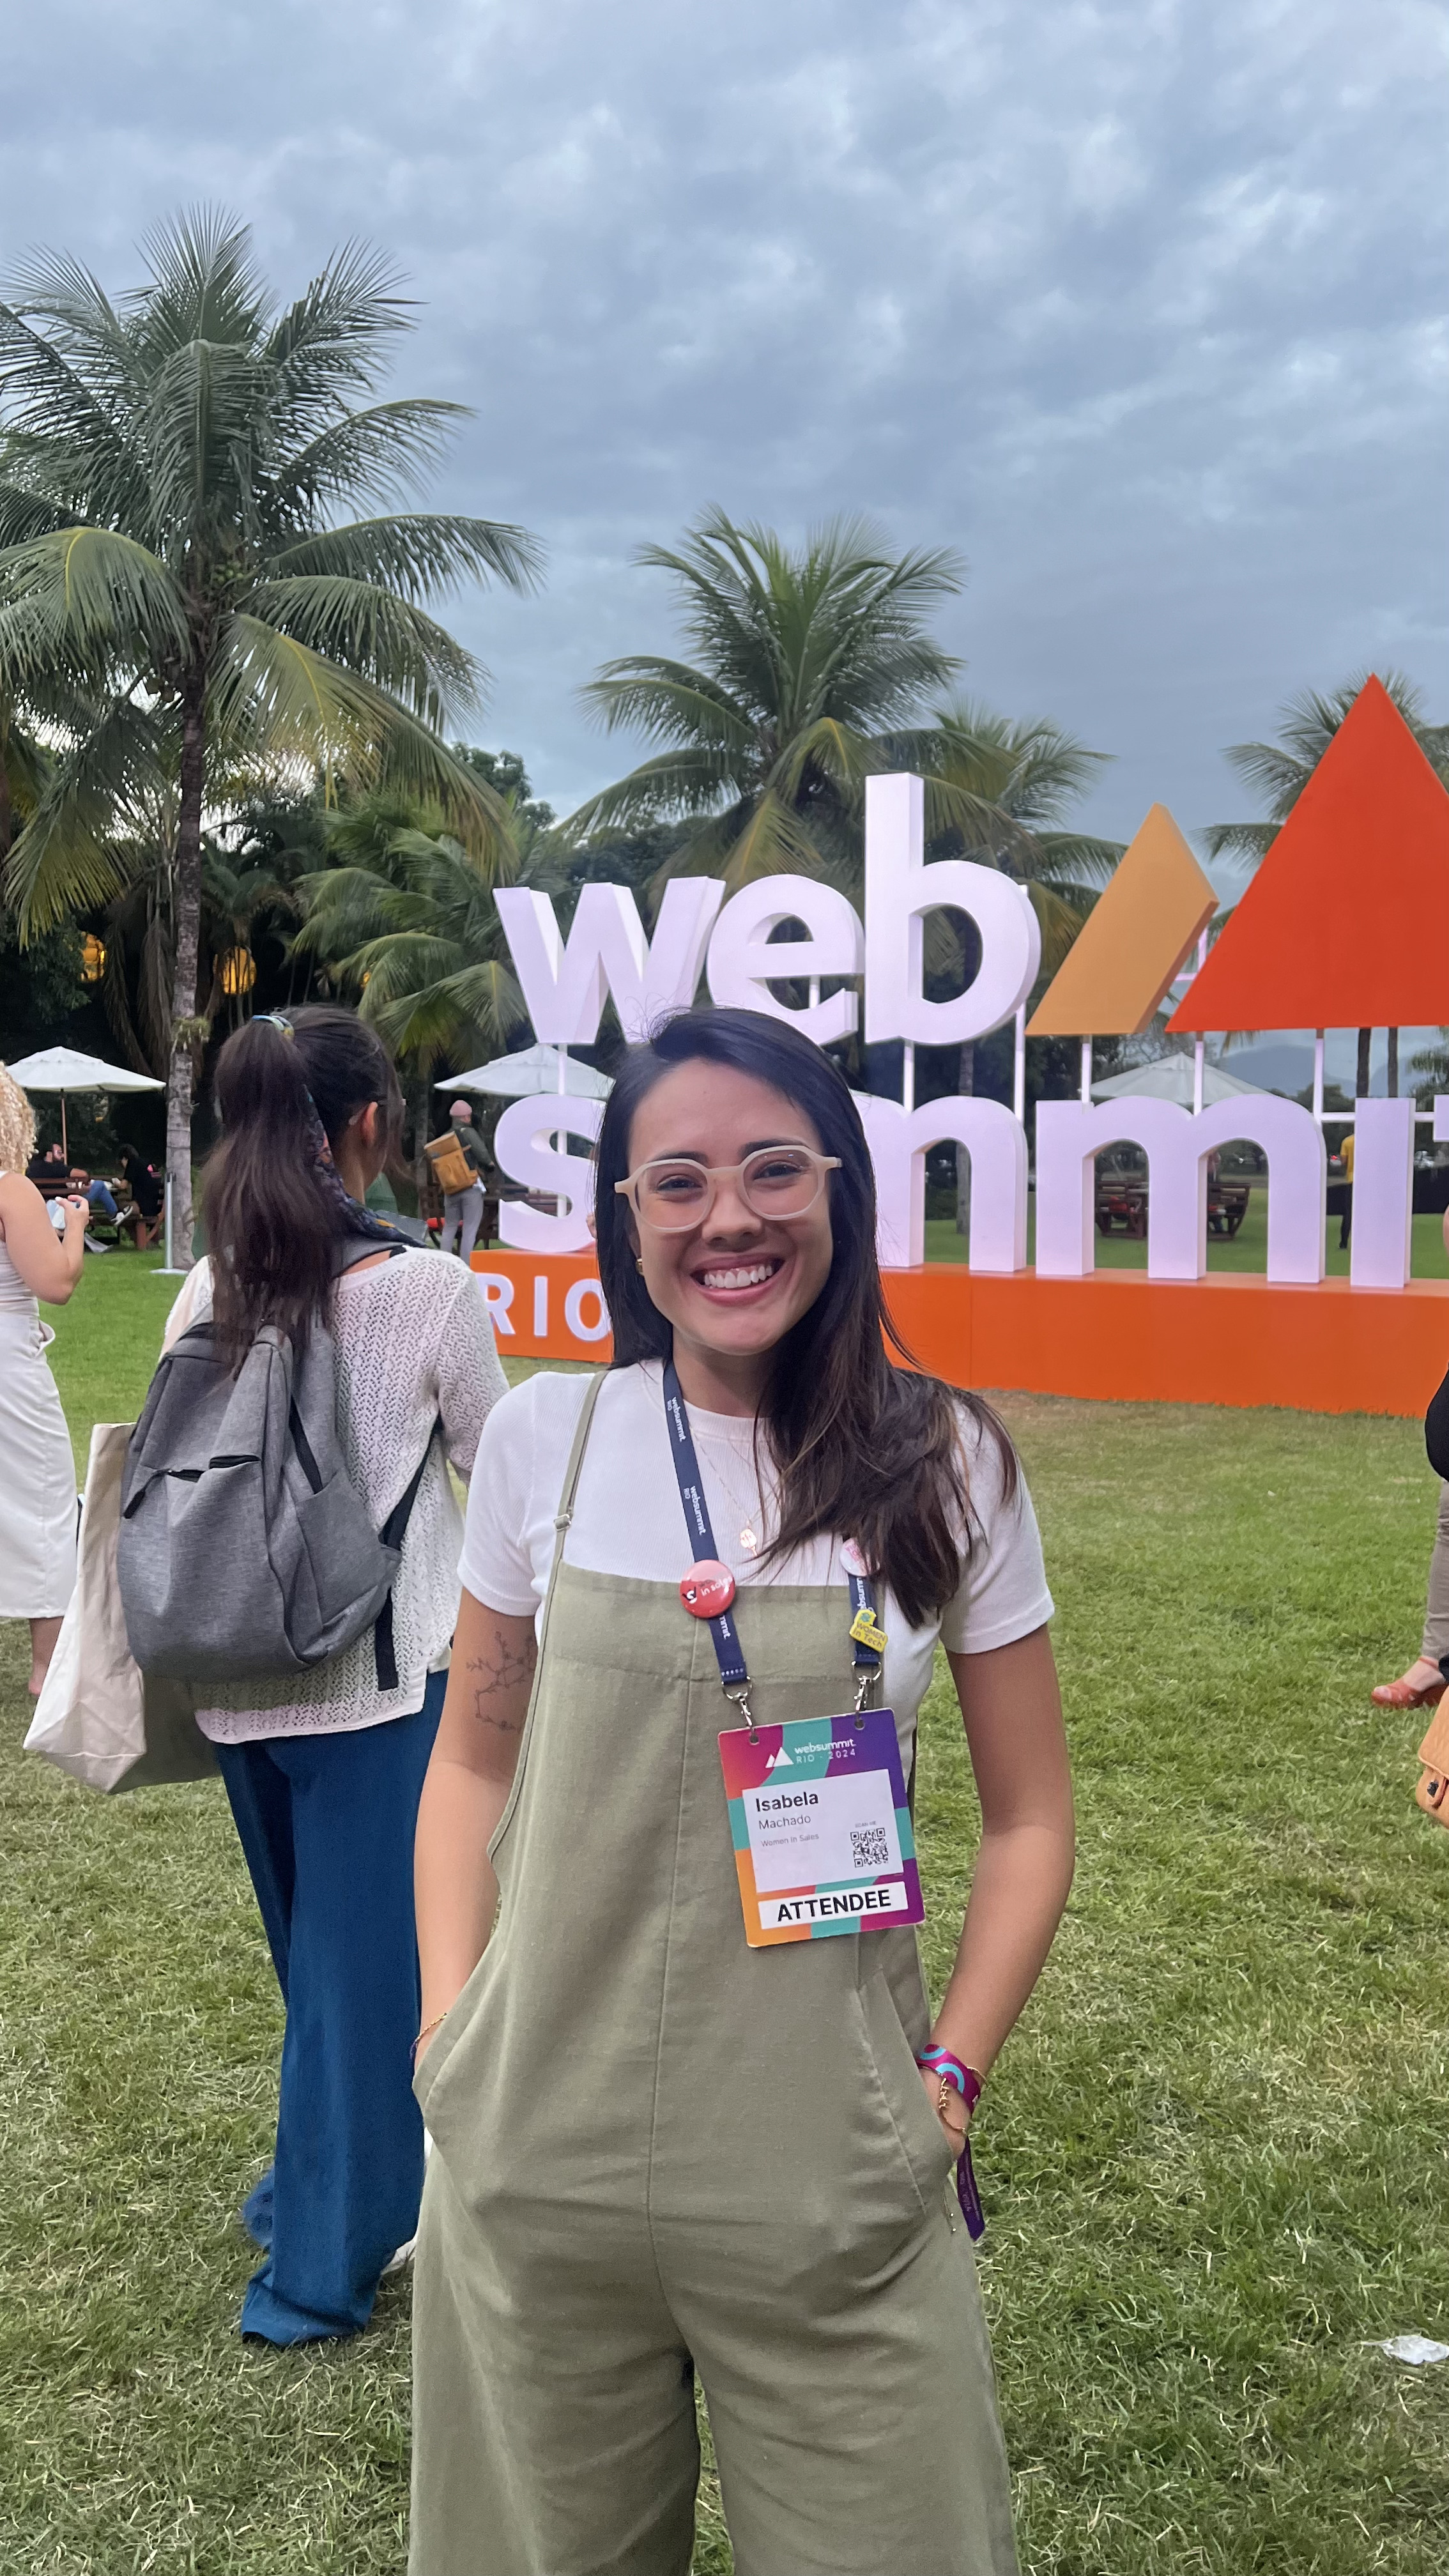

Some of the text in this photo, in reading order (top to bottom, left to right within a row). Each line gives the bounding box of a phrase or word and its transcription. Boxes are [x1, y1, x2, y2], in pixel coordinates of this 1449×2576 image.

[493, 772, 1041, 1045] web
[494, 1093, 1449, 1288] smmi
[475, 1272, 611, 1342] RIO
[671, 1397, 687, 1442] websummit
[690, 1485, 706, 1535] websummit
[857, 1621, 886, 1641] WOMEN
[864, 1633, 882, 1648] Tech
[794, 1738, 855, 1754] websummit
[796, 1754, 815, 1763] RIO
[828, 1749, 855, 1759] 2024
[756, 1791, 818, 1812] Isabela
[758, 1814, 811, 1830] Machado
[761, 1837, 789, 1847] Women
[778, 1889, 891, 1922] ATTENDEE
